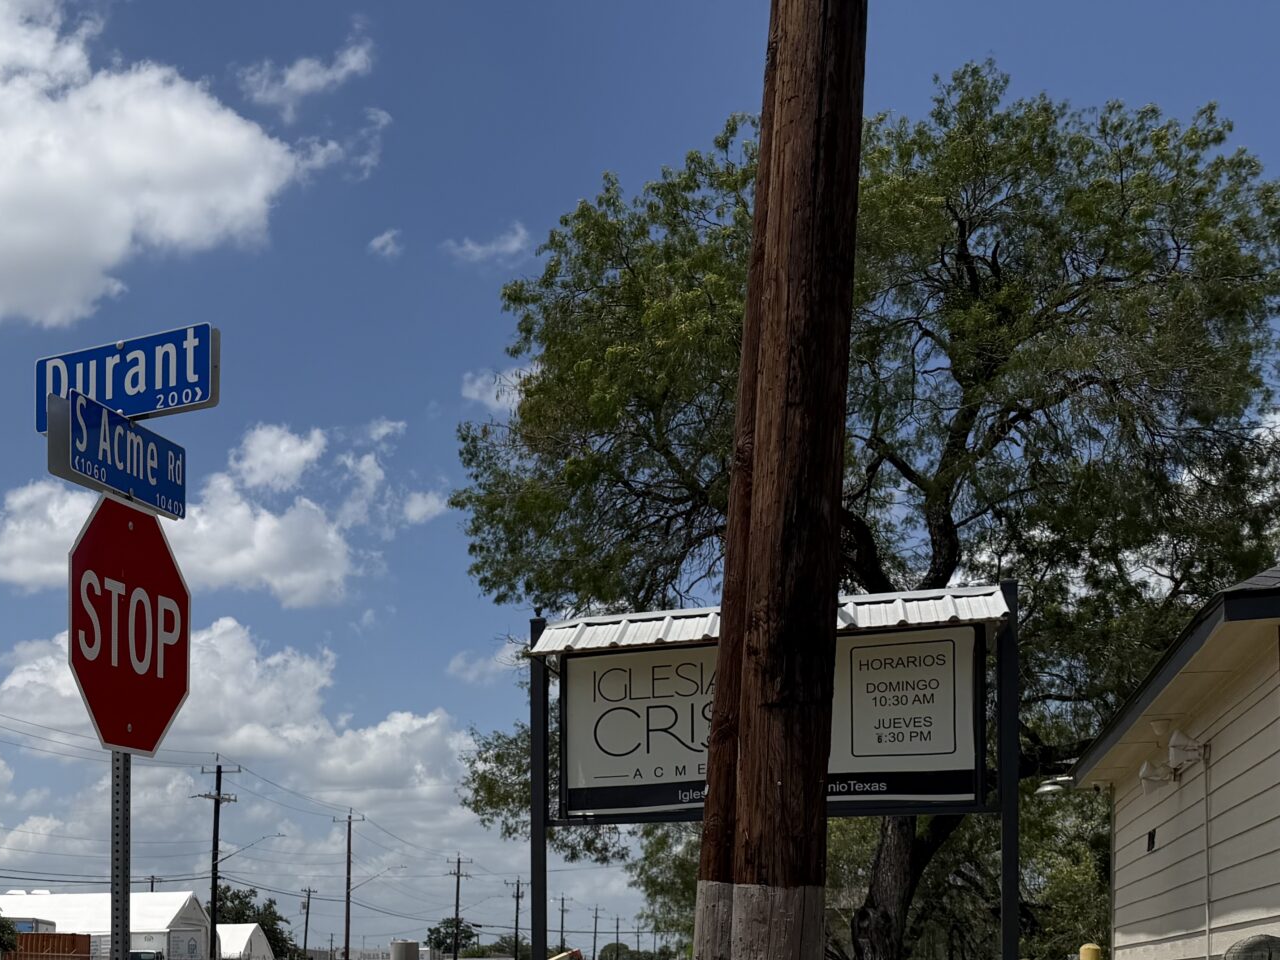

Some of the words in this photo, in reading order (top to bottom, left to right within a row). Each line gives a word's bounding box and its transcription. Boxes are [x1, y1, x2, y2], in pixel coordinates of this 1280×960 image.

[46, 327, 199, 404] Durant
[156, 388, 192, 409] 200
[75, 395, 88, 452] S
[98, 408, 158, 486] Acme
[168, 450, 183, 486] Rd
[81, 458, 107, 482] 1060
[156, 493, 179, 515] 1040
[78, 569, 181, 679] STOP
[859, 654, 946, 671] HORARIOS
[866, 679, 940, 693] DOMINGO
[872, 694, 908, 707] 10:30
[912, 693, 935, 705] AM
[874, 716, 933, 730] JUEVES
[909, 731, 932, 742] PM
[633, 763, 707, 779] ACME
